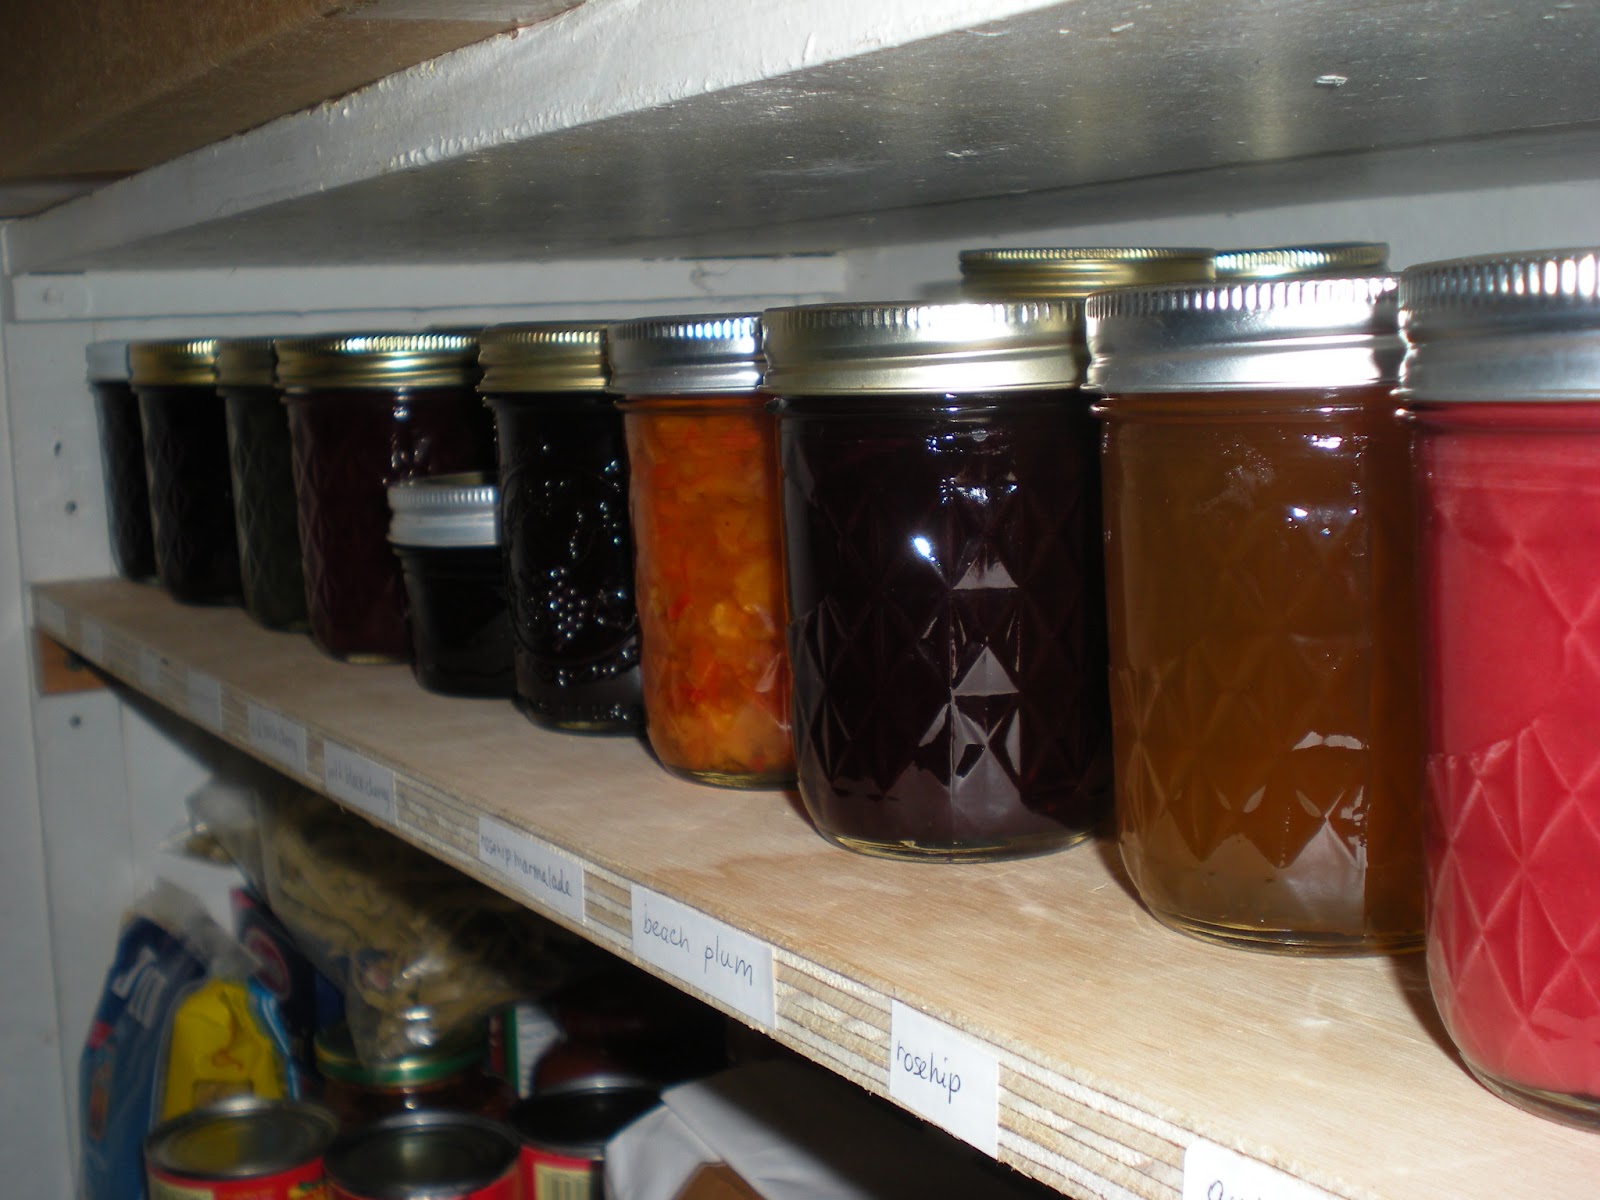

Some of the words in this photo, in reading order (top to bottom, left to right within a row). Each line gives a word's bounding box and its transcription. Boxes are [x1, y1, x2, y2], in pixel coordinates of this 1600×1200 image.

[513, 850, 573, 898] marmalade
[643, 903, 690, 953] beach
[704, 935, 754, 986] plum
[896, 1039, 962, 1105] rosehip
